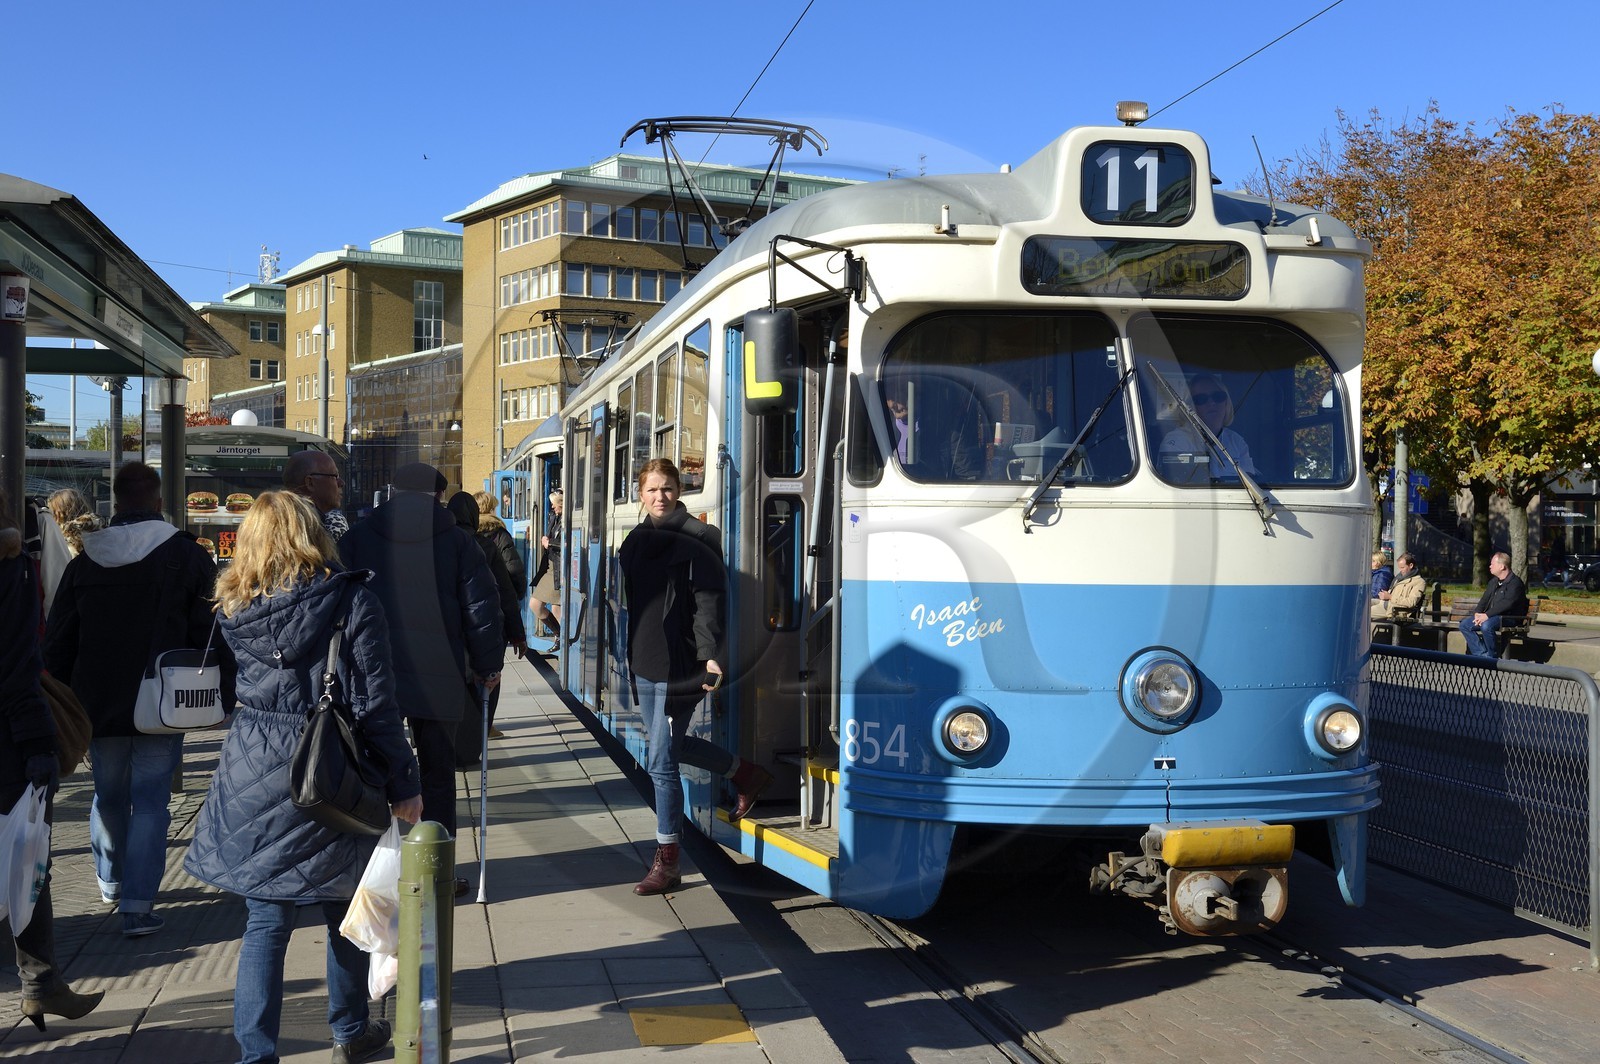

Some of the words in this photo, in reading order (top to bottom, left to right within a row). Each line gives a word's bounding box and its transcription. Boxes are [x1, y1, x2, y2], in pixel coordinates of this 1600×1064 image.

[1096, 148, 1158, 212] 11
[216, 446, 261, 455] Järntorget
[911, 597, 982, 630] Isaac
[942, 618, 1005, 647] Béen
[174, 688, 215, 709] PUMA
[844, 718, 909, 767] 854
